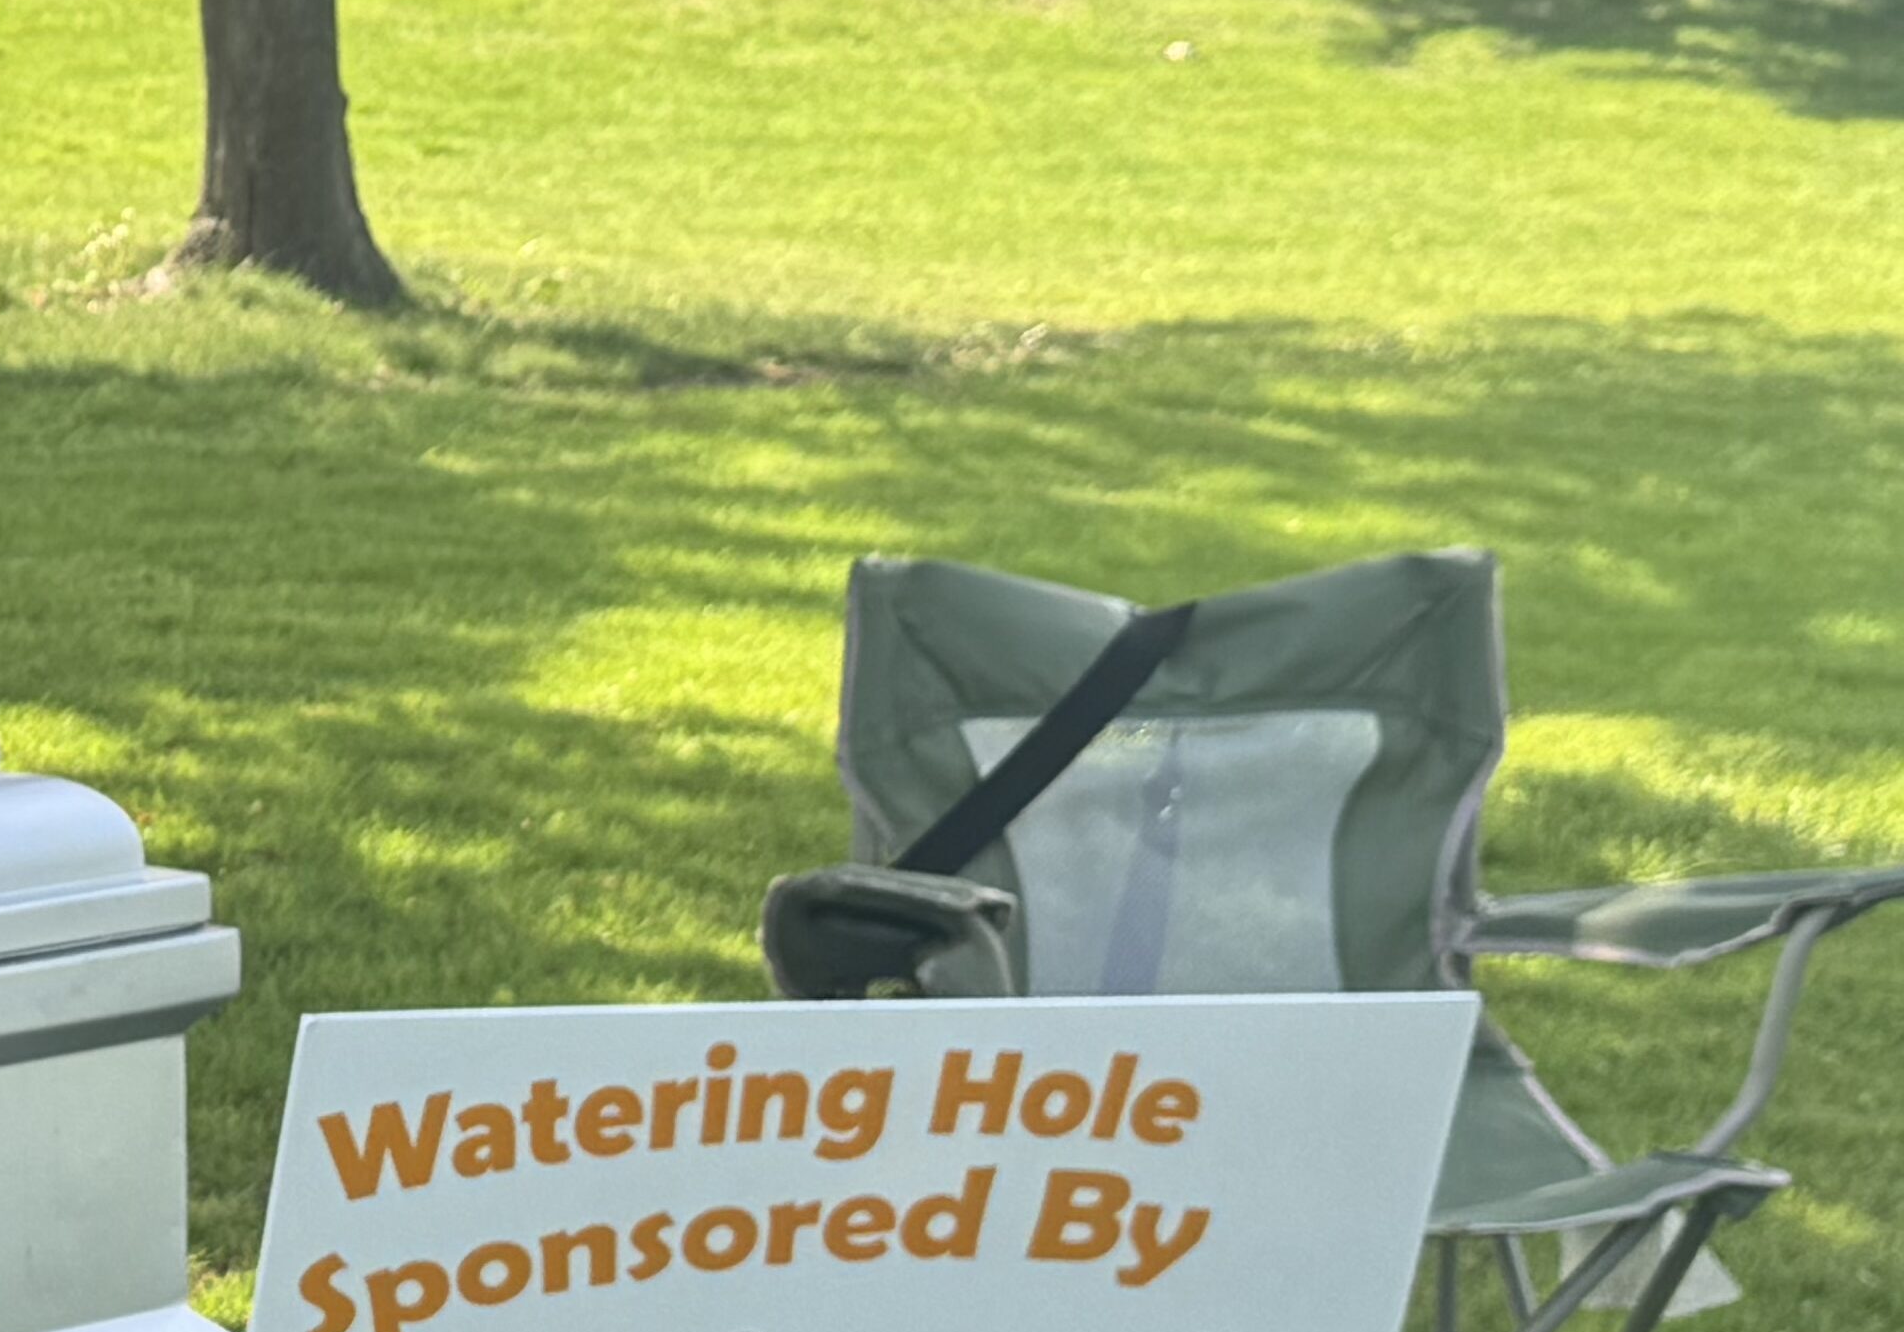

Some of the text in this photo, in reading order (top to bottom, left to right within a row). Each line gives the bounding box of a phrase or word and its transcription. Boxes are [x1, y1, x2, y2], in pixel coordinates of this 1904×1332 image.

[318, 1042, 1201, 1201] Watering Hole
[1026, 1169, 1211, 1288] By
